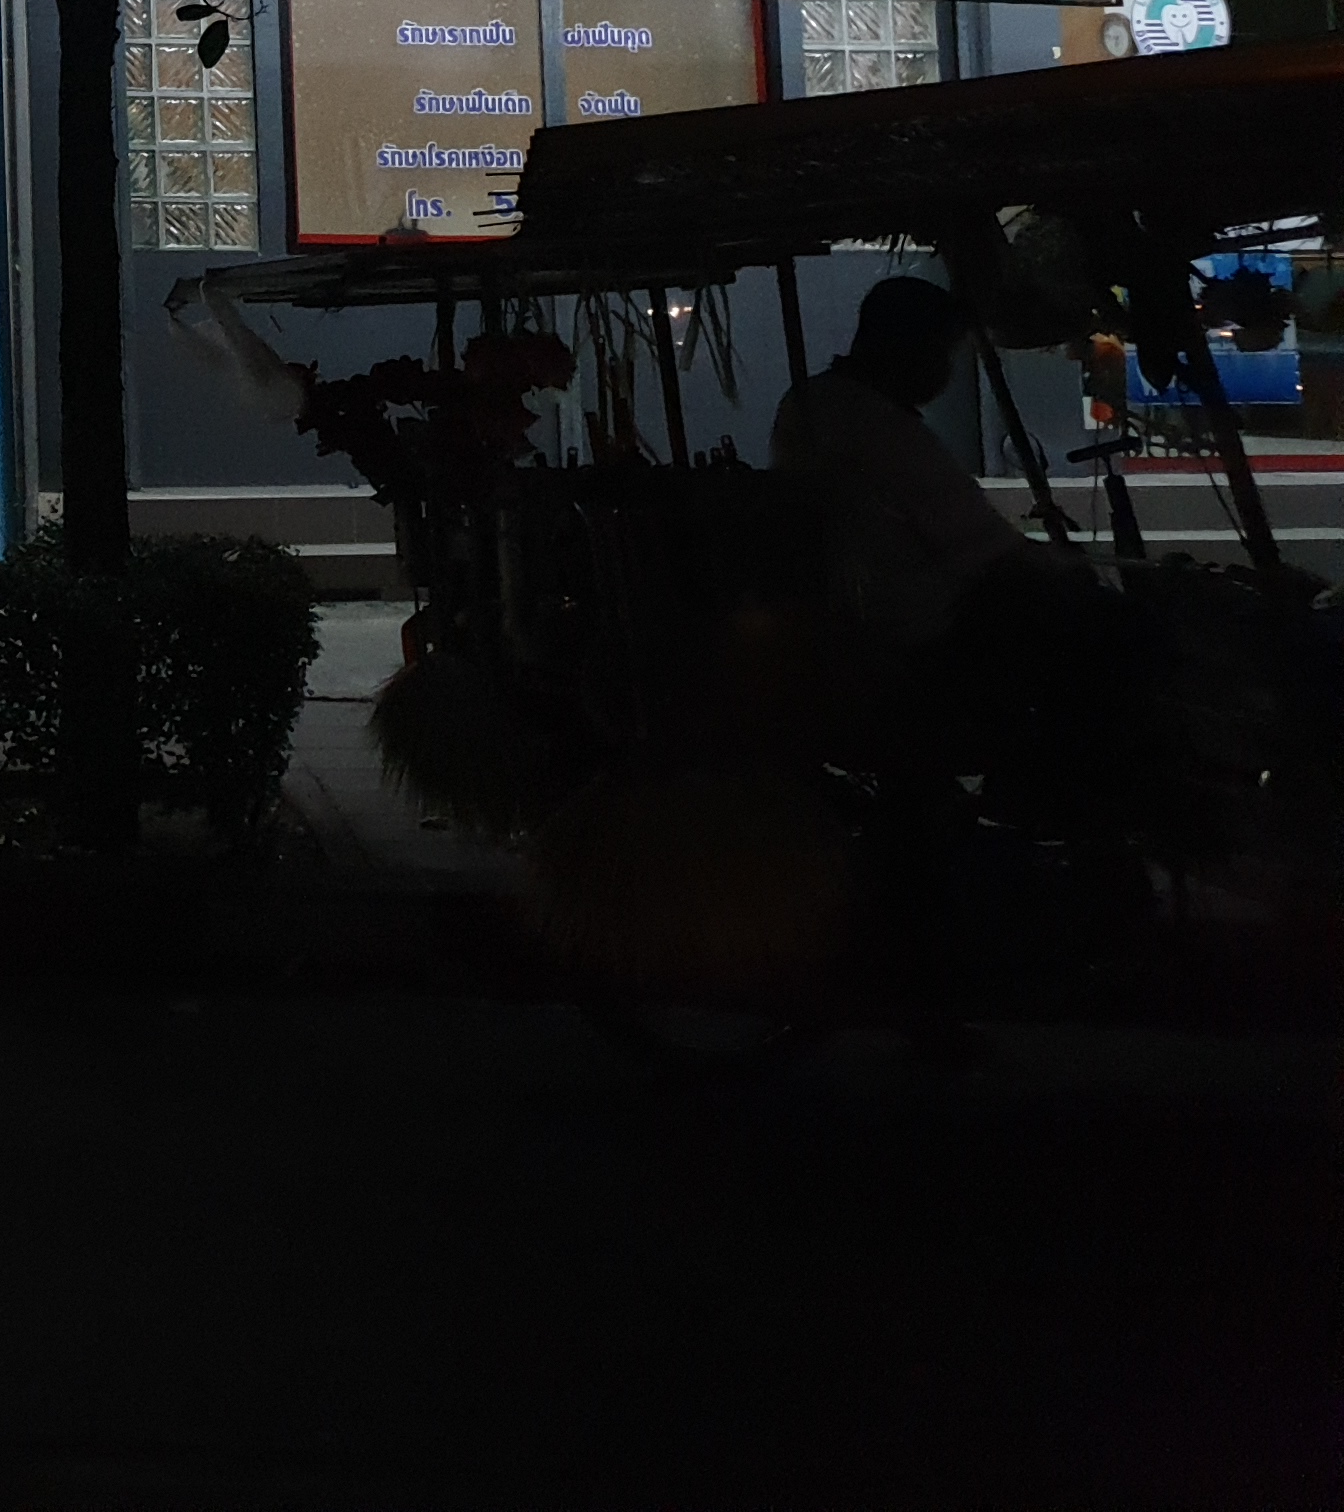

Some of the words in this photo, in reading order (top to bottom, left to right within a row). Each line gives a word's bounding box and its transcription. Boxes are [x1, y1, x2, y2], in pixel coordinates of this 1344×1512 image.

[397, 20, 516, 46] รักษารากฟัน
[563, 21, 652, 53] ผ่าฟันคุด
[414, 89, 532, 115] รักษาฟันเด็ก
[578, 89, 641, 116] จัดฟัน
[377, 142, 523, 168] รักษาโรคเหงือก
[406, 189, 453, 219] โทร.
